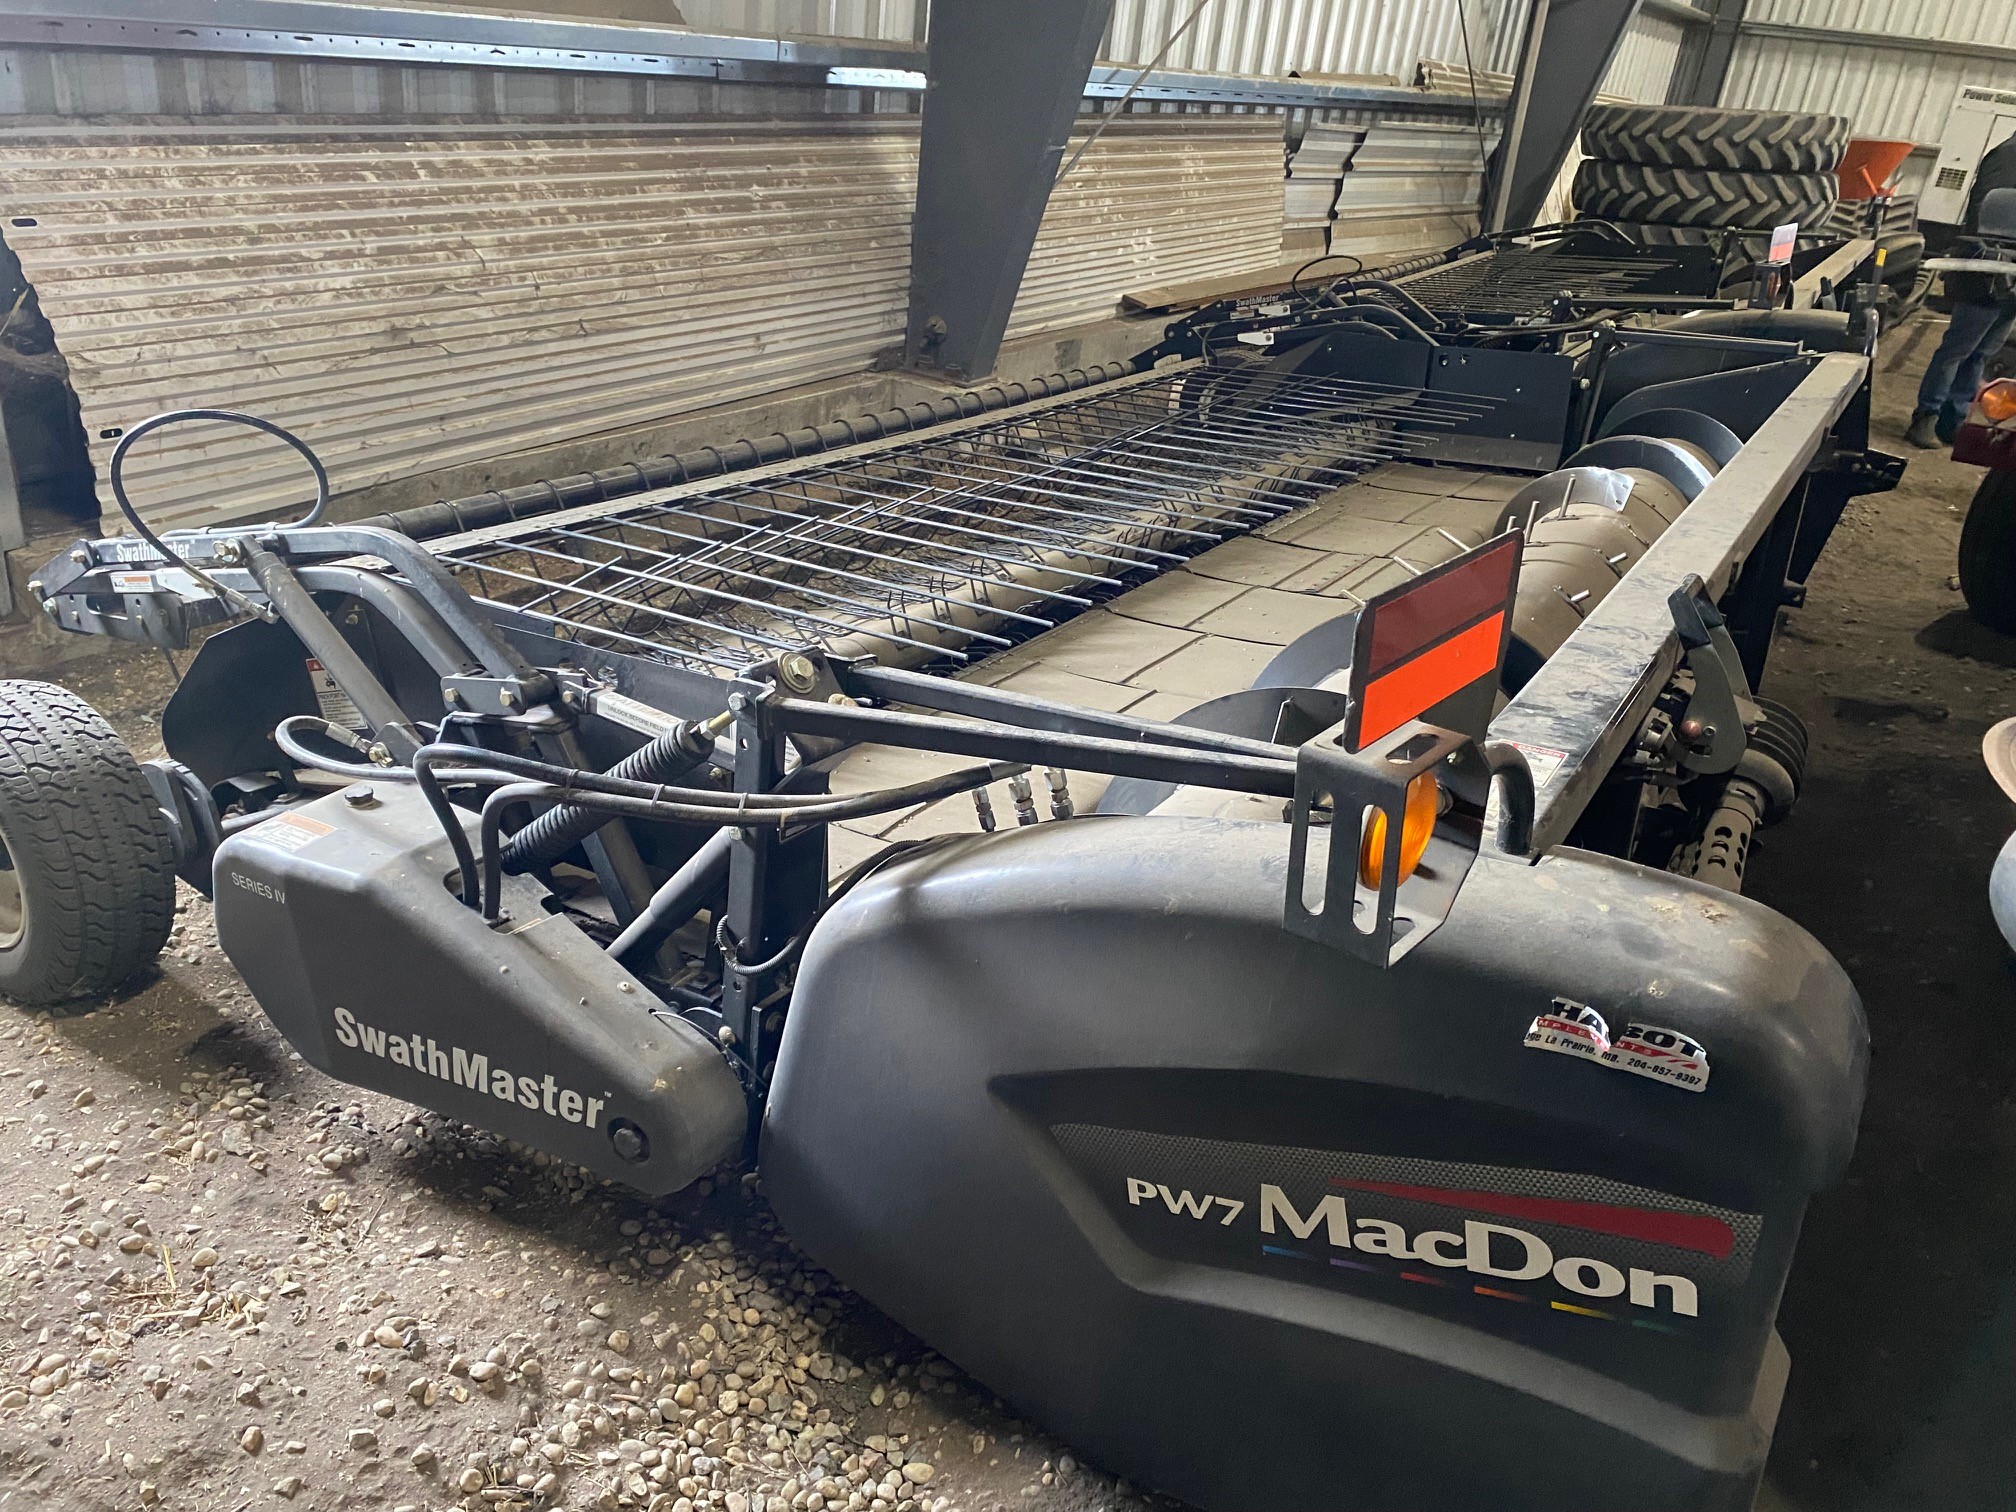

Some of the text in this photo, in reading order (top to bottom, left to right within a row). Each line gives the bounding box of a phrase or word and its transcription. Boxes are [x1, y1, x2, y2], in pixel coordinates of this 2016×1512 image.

[1236, 294, 1280, 306] SwathMaster
[607, 705, 629, 718] UNLOCK
[629, 713, 650, 726] BEFORE
[650, 721, 664, 732] FIELD
[1518, 744, 1559, 757] DANGER
[231, 872, 285, 904] SERIES IV
[1545, 1034, 1558, 1044] La
[1553, 1000, 1705, 1057] HABOT
[1126, 1177, 1698, 1317] PW7 MacDon
